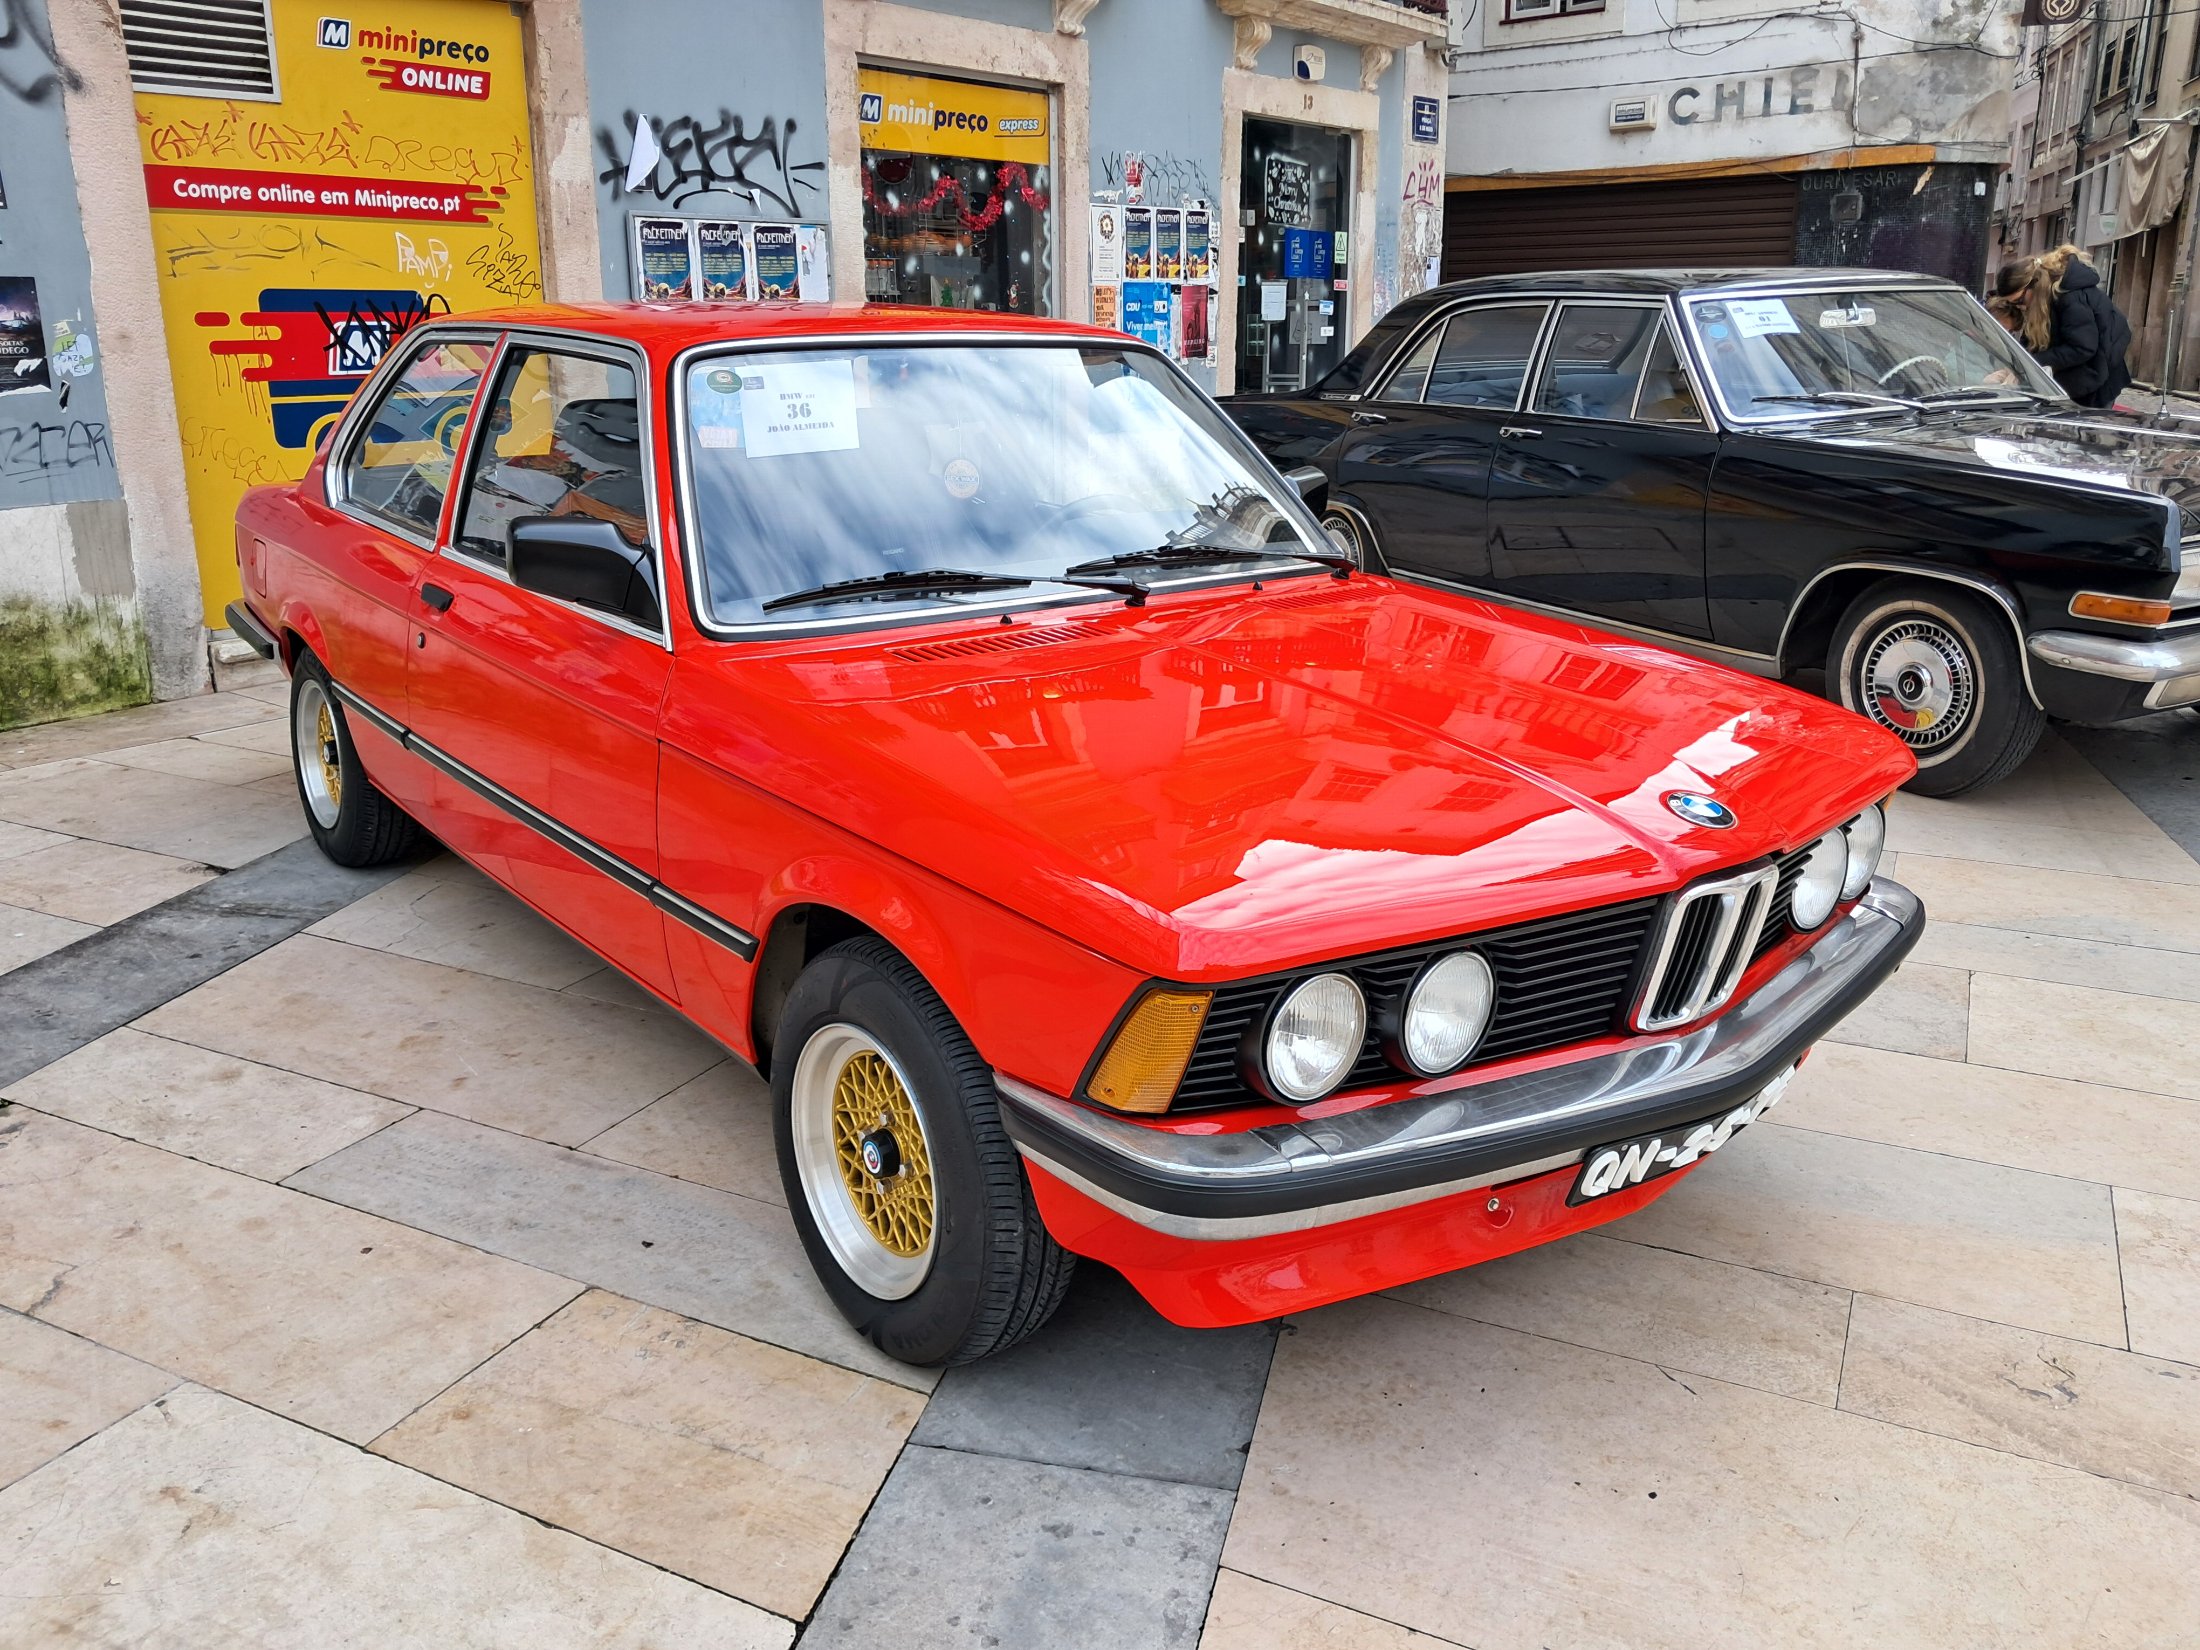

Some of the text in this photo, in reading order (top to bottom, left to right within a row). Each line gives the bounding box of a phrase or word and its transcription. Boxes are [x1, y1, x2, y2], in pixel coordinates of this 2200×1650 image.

[358, 25, 490, 64] minipreço
[401, 67, 484, 95] ONLINE
[1303, 94, 1314, 110] 13
[887, 98, 989, 135] minipreço
[999, 118, 1039, 134] express
[173, 178, 461, 215] Compre online em Minipreco.pt
[1126, 302, 1141, 312] CDU
[779, 392, 803, 401] BMW
[786, 402, 812, 420] 36
[793, 421, 835, 432] ALMEIDA
